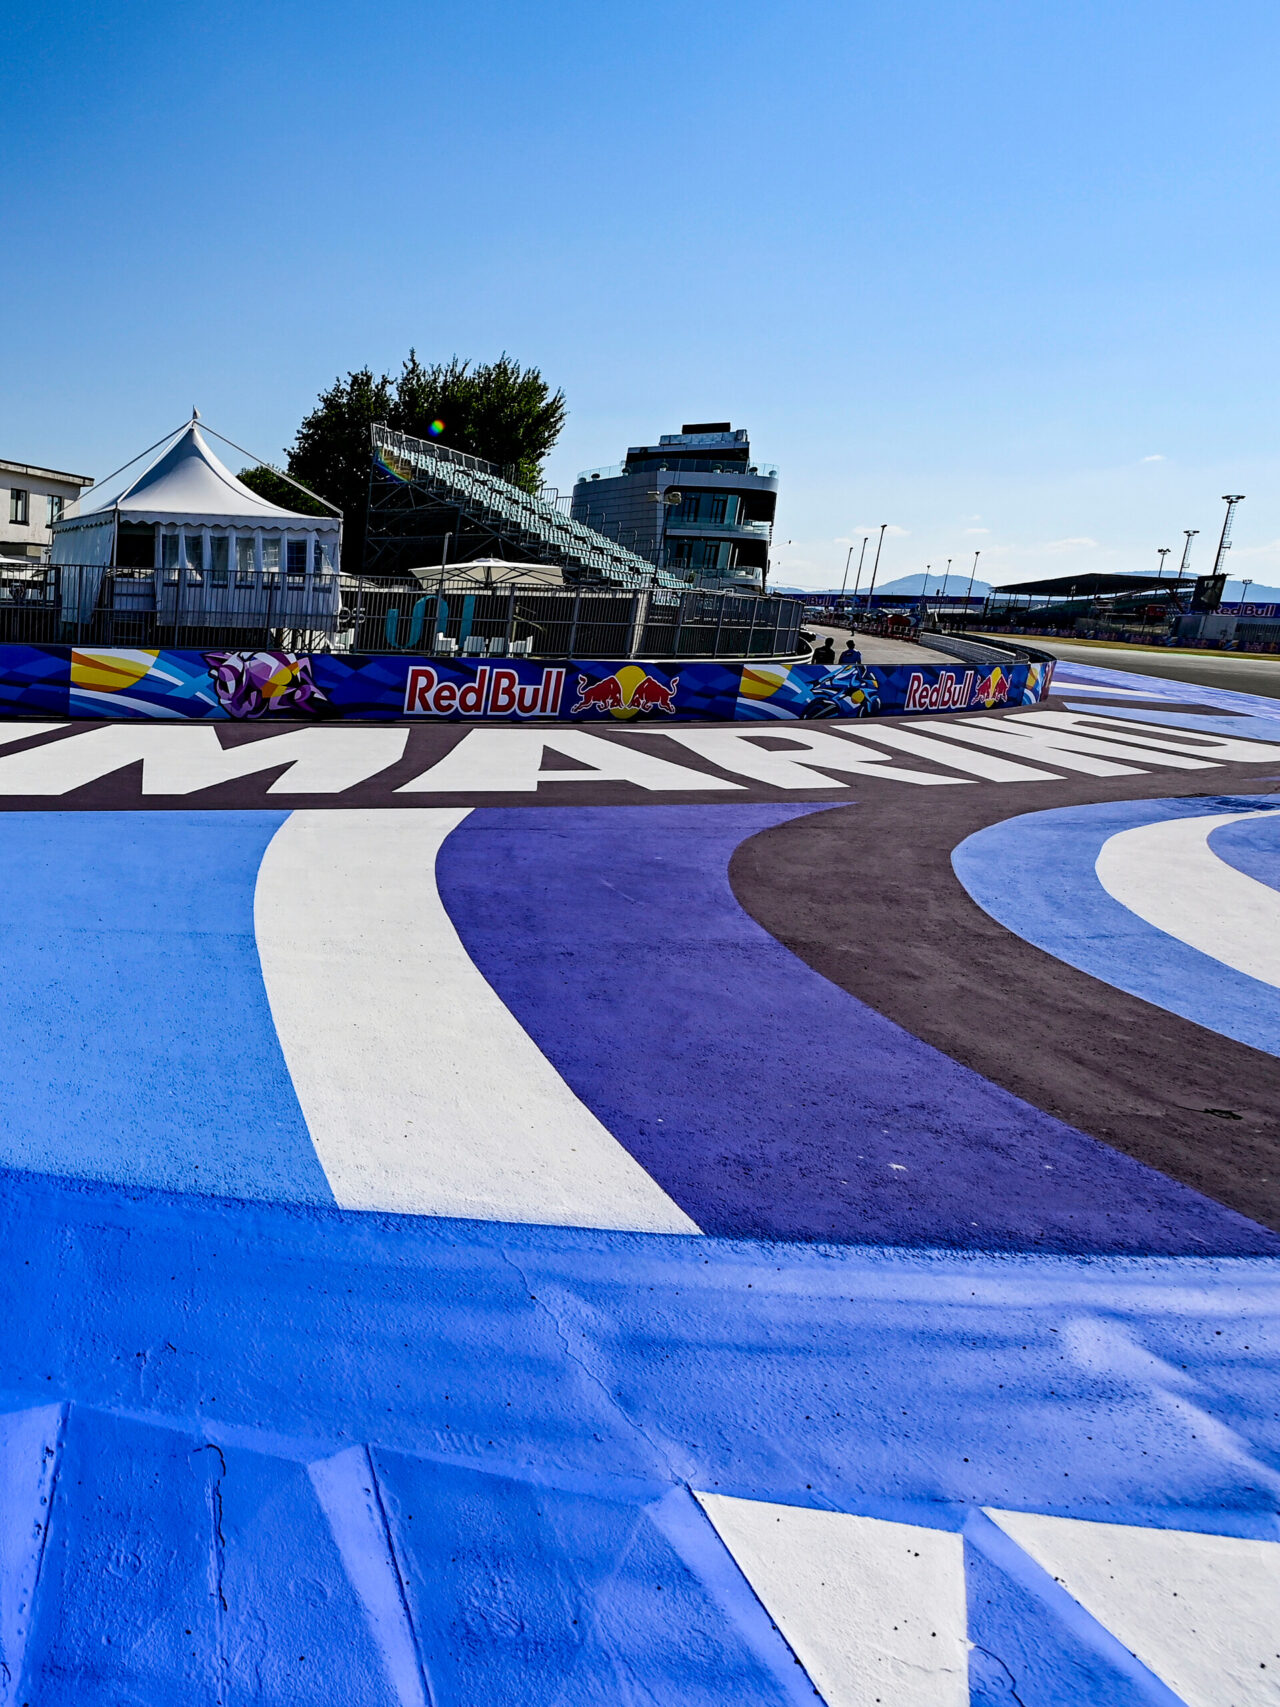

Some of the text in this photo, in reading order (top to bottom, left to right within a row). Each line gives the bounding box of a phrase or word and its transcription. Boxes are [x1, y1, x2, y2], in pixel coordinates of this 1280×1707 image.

[1242, 604, 1276, 617] Bull
[404, 666, 566, 716] Red Bull
[904, 671, 974, 710] Red Bull
